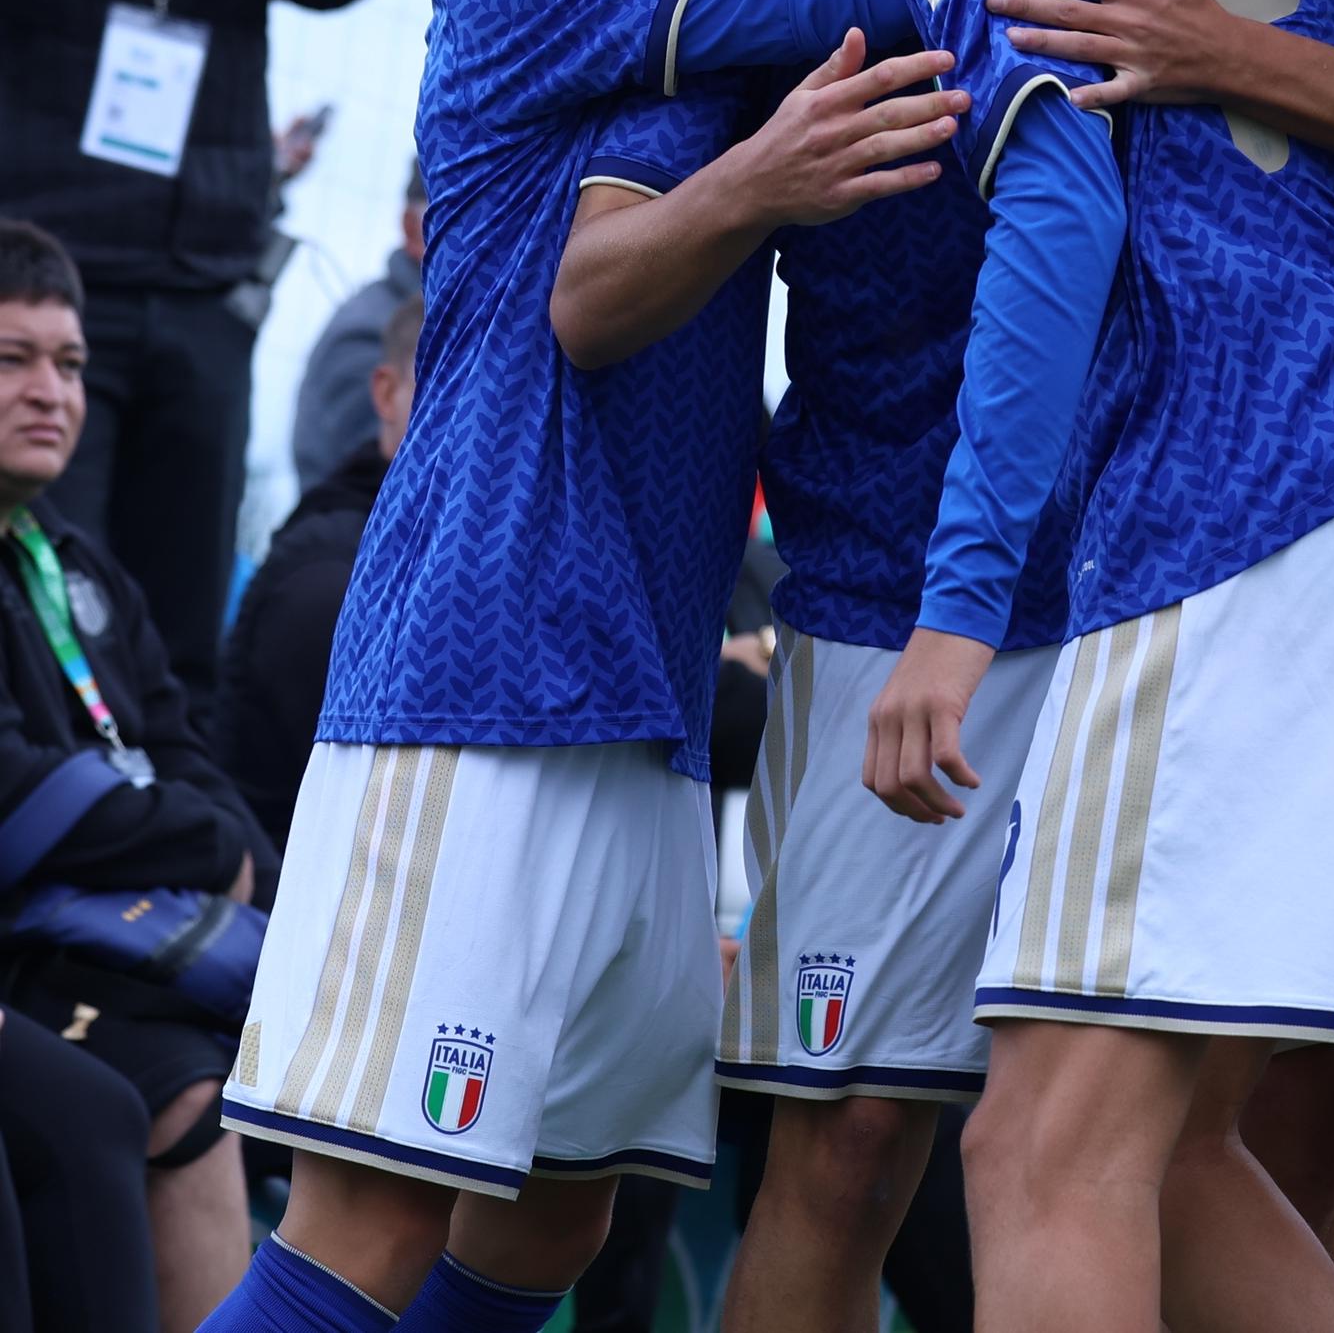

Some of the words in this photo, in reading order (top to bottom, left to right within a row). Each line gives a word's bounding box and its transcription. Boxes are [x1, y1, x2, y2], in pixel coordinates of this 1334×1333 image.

[801, 973, 845, 991] ITALIA
[435, 1045, 485, 1071] ITALIA
[452, 1066, 467, 1075] FIGC
